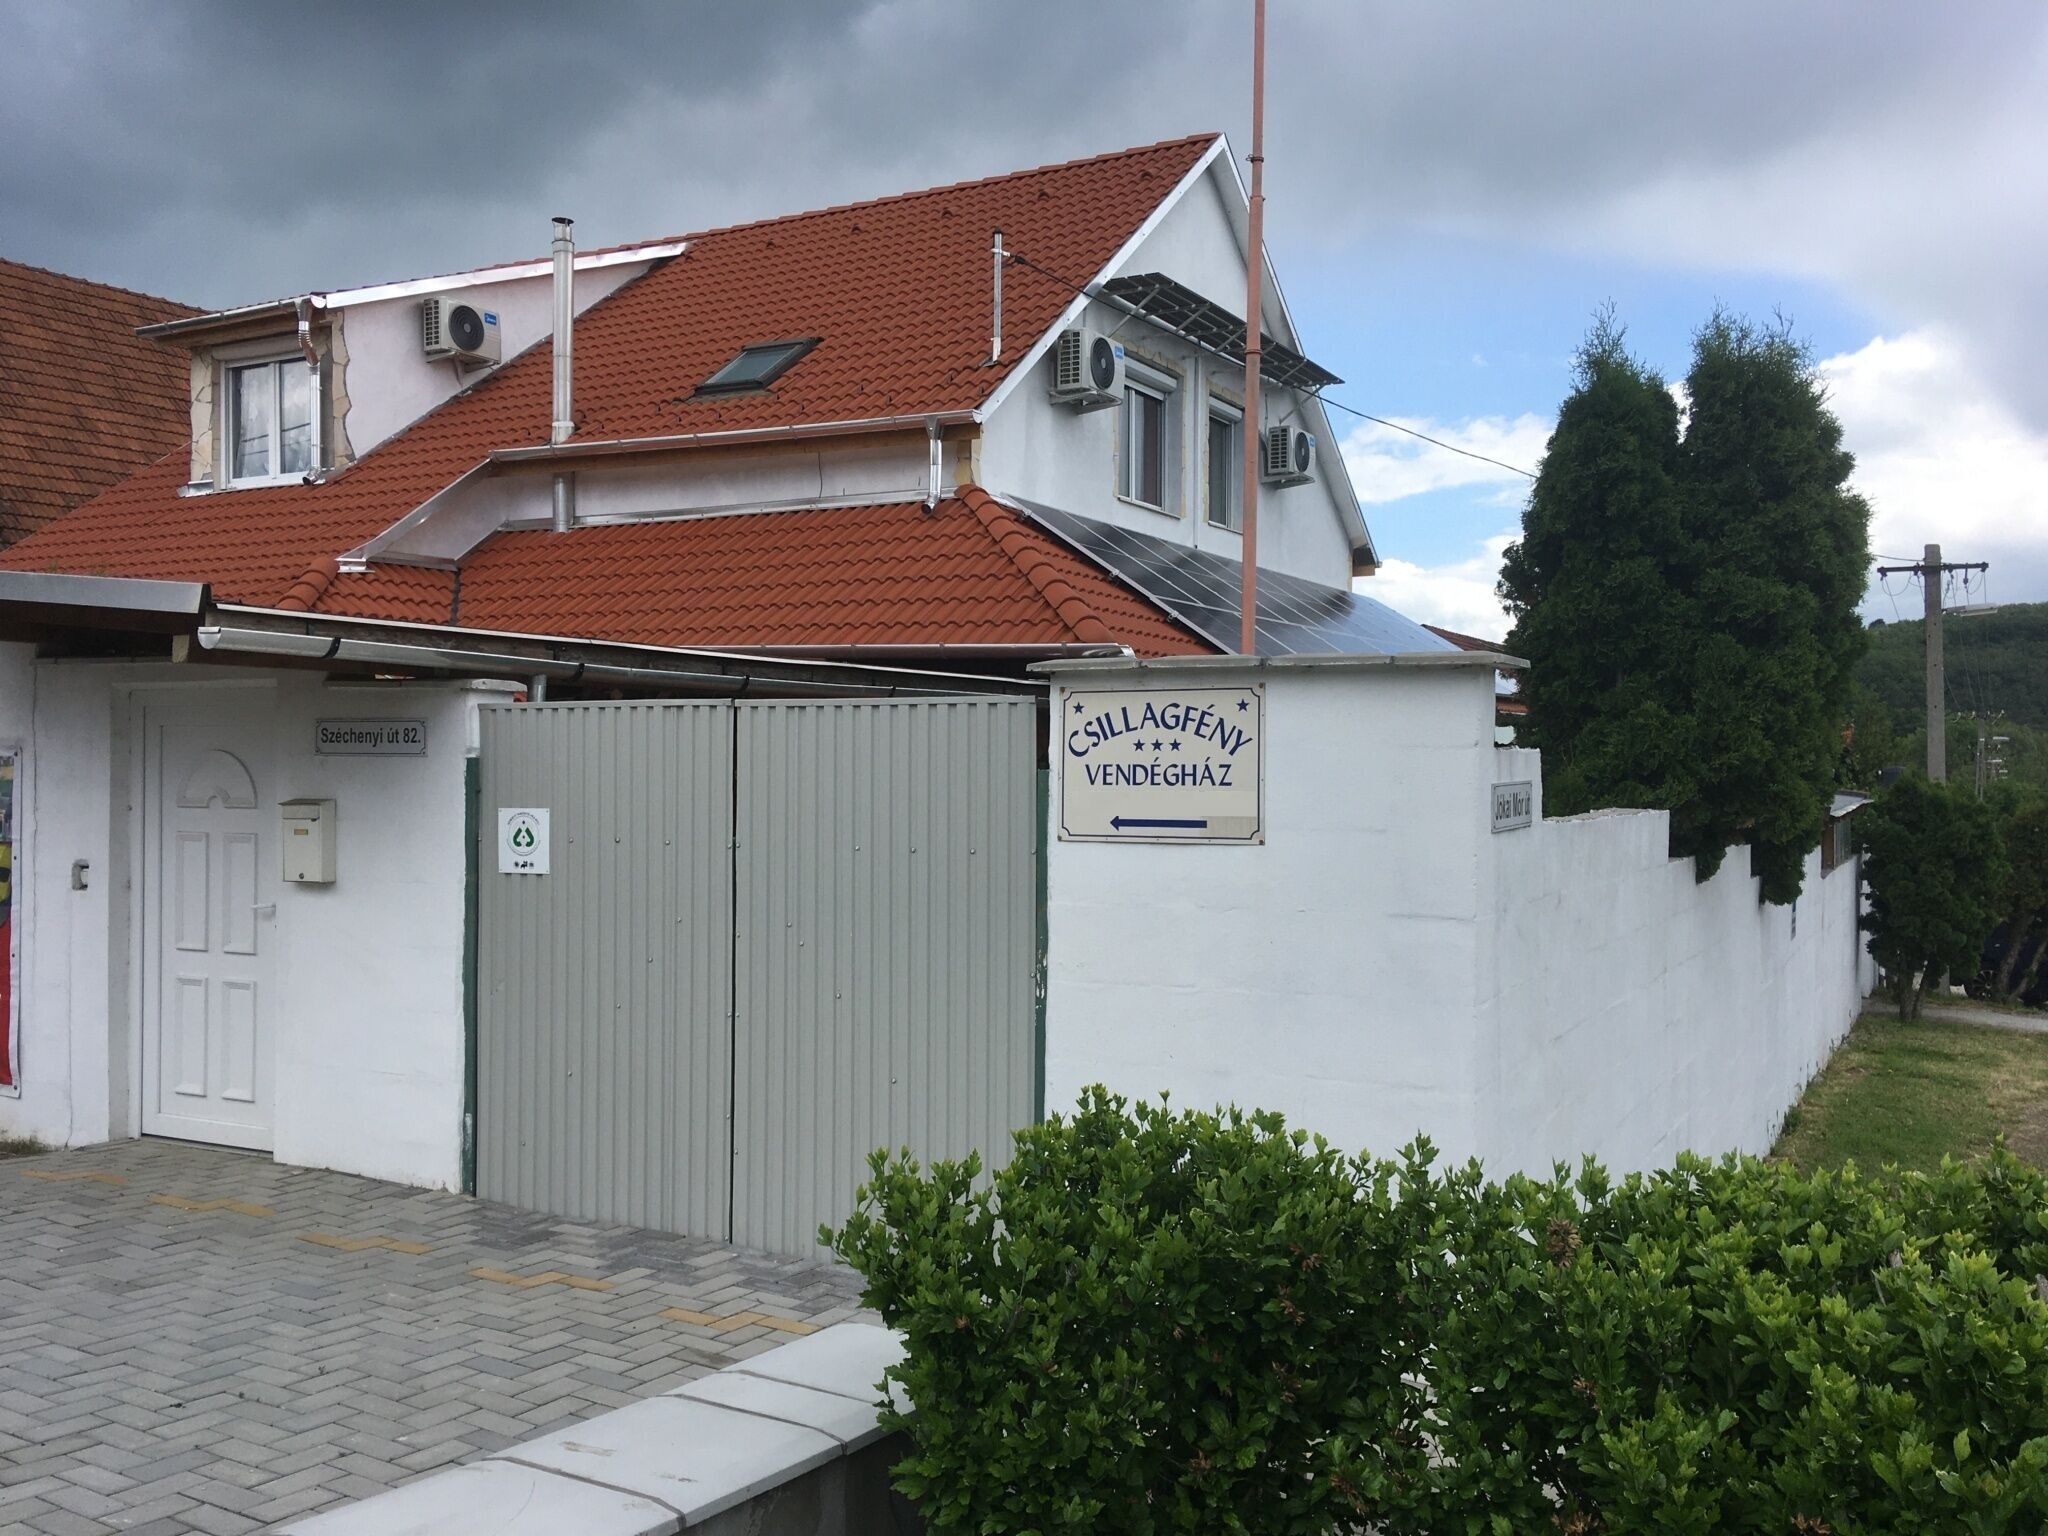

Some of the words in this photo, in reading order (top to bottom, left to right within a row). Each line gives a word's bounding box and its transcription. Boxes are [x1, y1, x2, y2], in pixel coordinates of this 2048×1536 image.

[321, 728, 383, 748] Széchenyi
[387, 728, 400, 743] út
[402, 728, 421, 743] 82.
[1068, 702, 1253, 758] CSILLAGFÉNY
[1085, 756, 1233, 787] VENDÉGHÁZ
